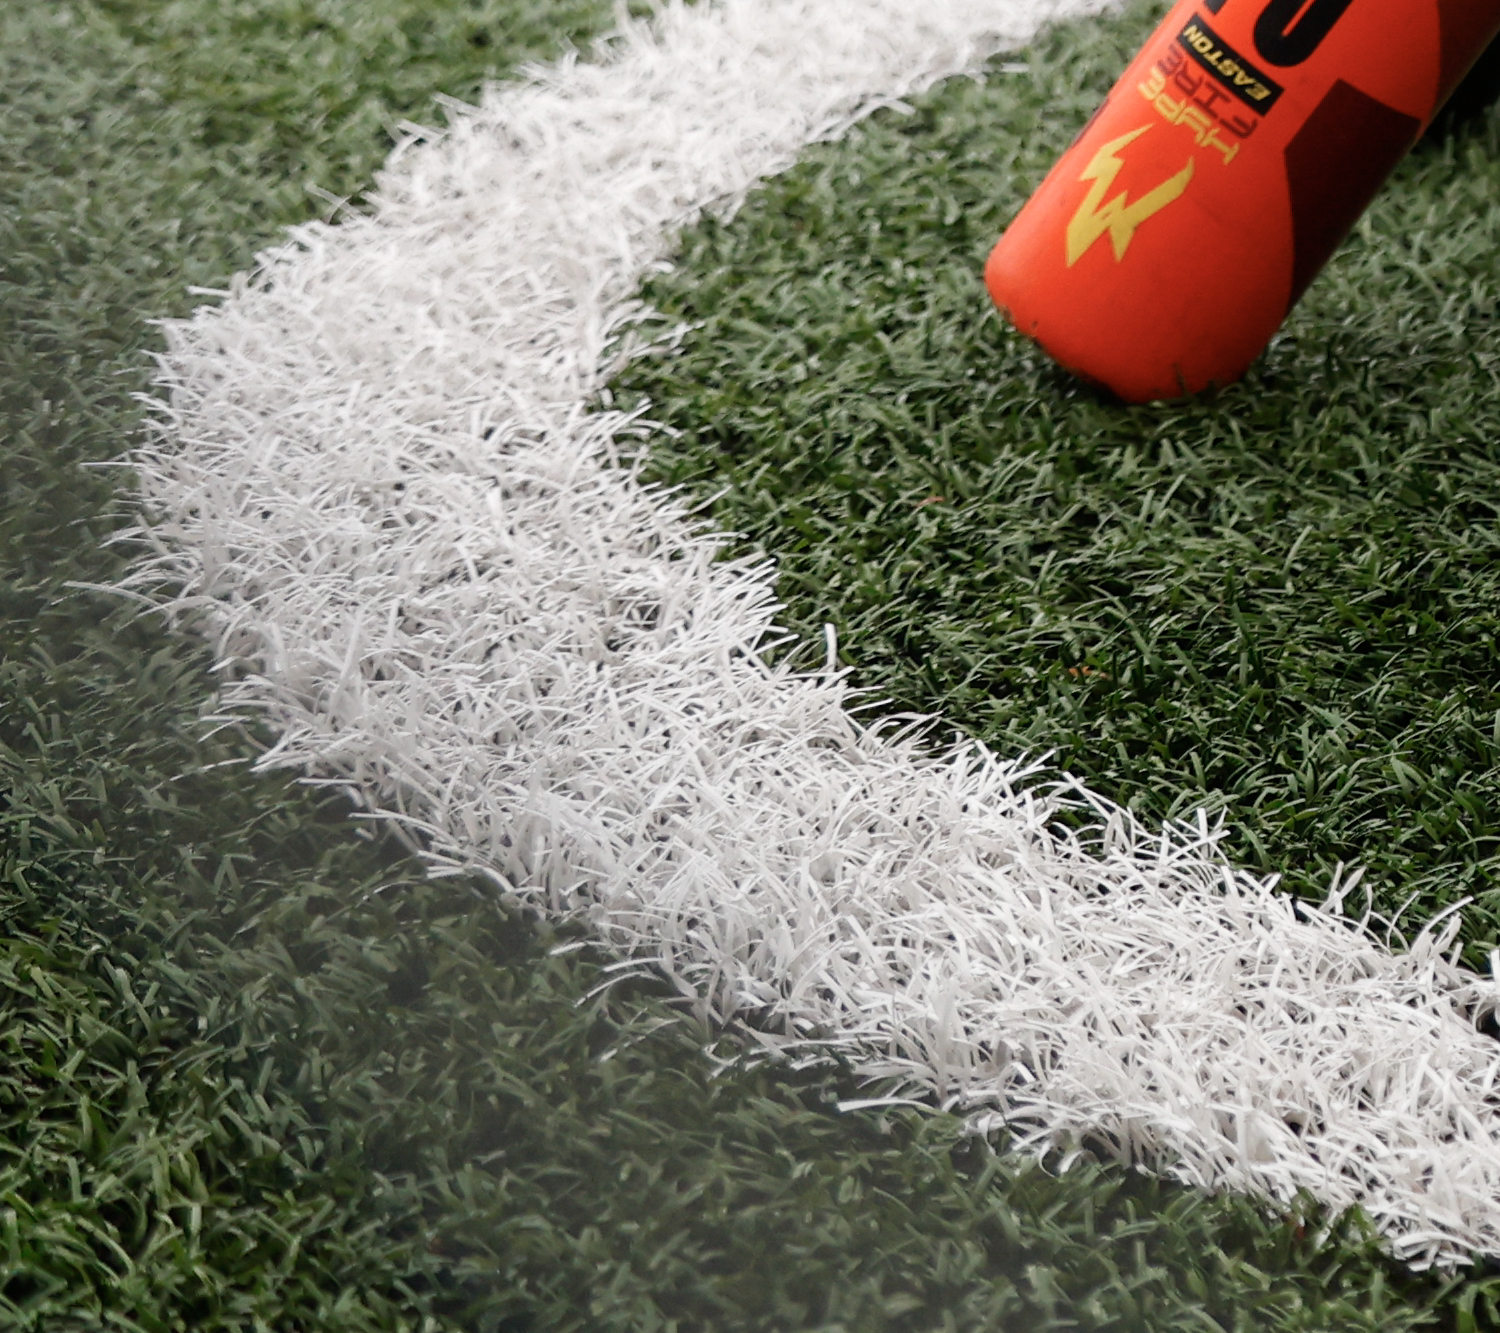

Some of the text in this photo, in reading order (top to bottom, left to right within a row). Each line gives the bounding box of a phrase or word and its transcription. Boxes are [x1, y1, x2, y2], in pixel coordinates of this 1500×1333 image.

[1152, 43, 1261, 142] FIRE
[1180, 20, 1273, 105] EASTON
[1133, 65, 1241, 167] HYPE
